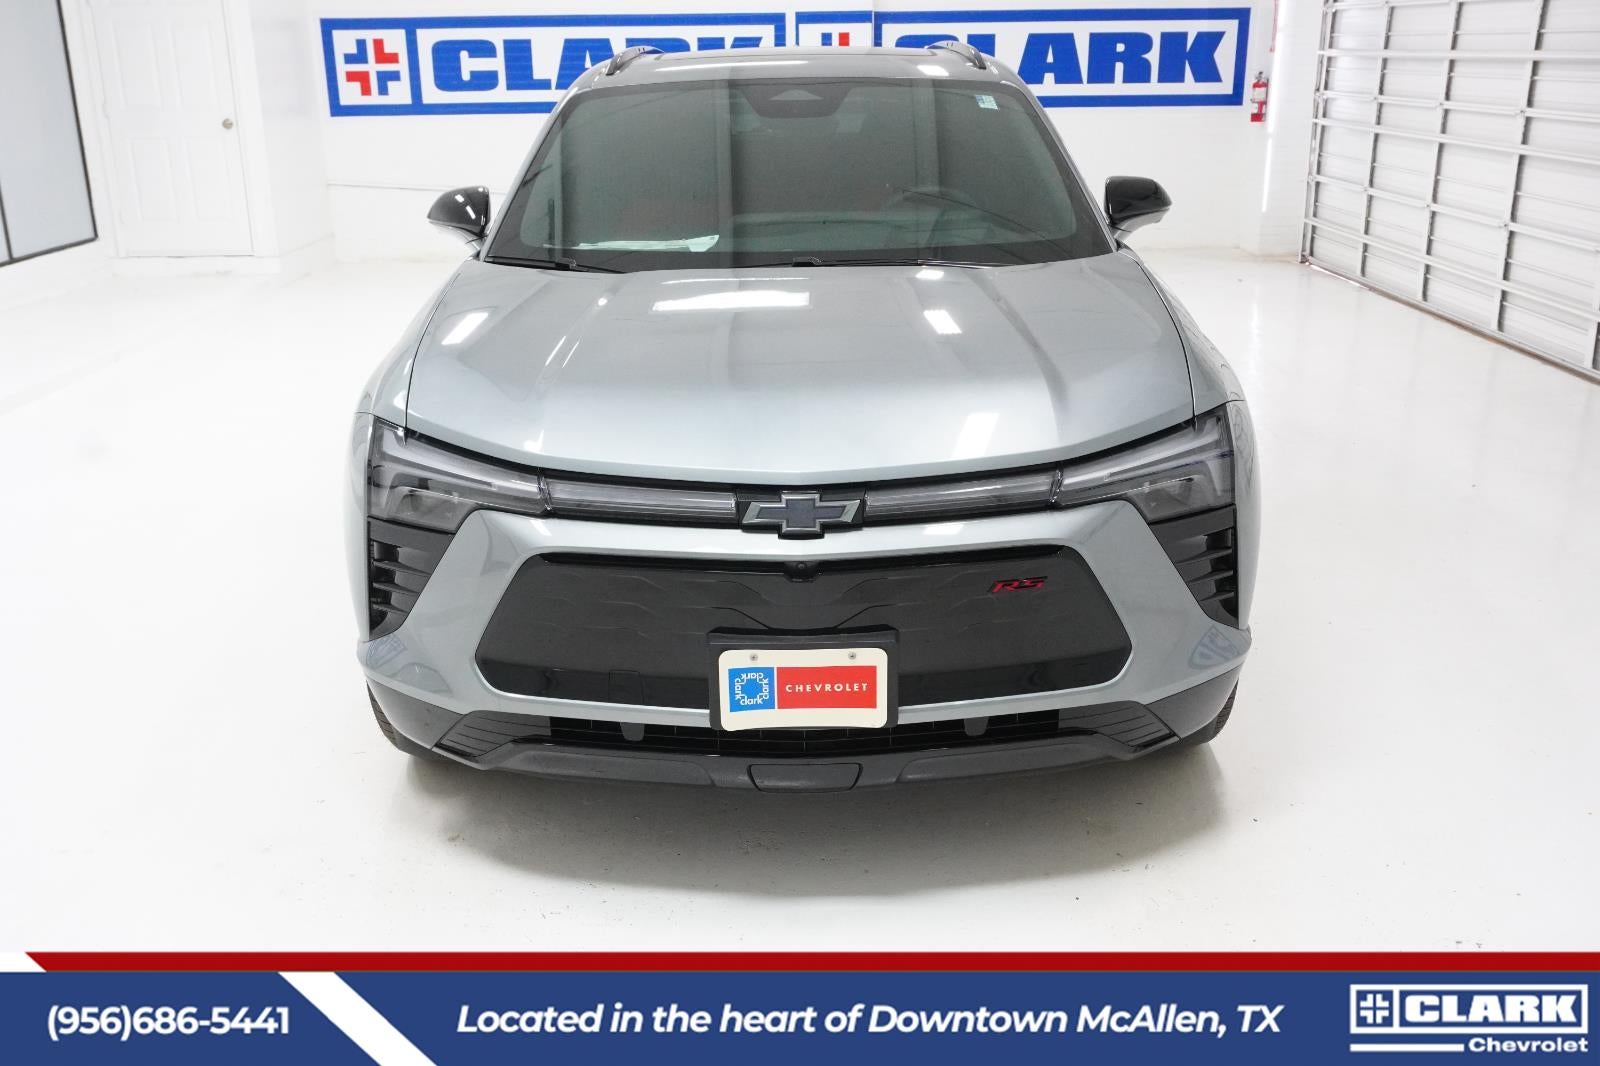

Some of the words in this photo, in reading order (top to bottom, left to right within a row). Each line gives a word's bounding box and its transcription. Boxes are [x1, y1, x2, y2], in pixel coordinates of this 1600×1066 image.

[431, 36, 763, 92] CLA
[895, 31, 1227, 85] ARK
[987, 576, 1048, 593] RS
[785, 682, 868, 693] CHEVROLET
[740, 693, 764, 706] clark
